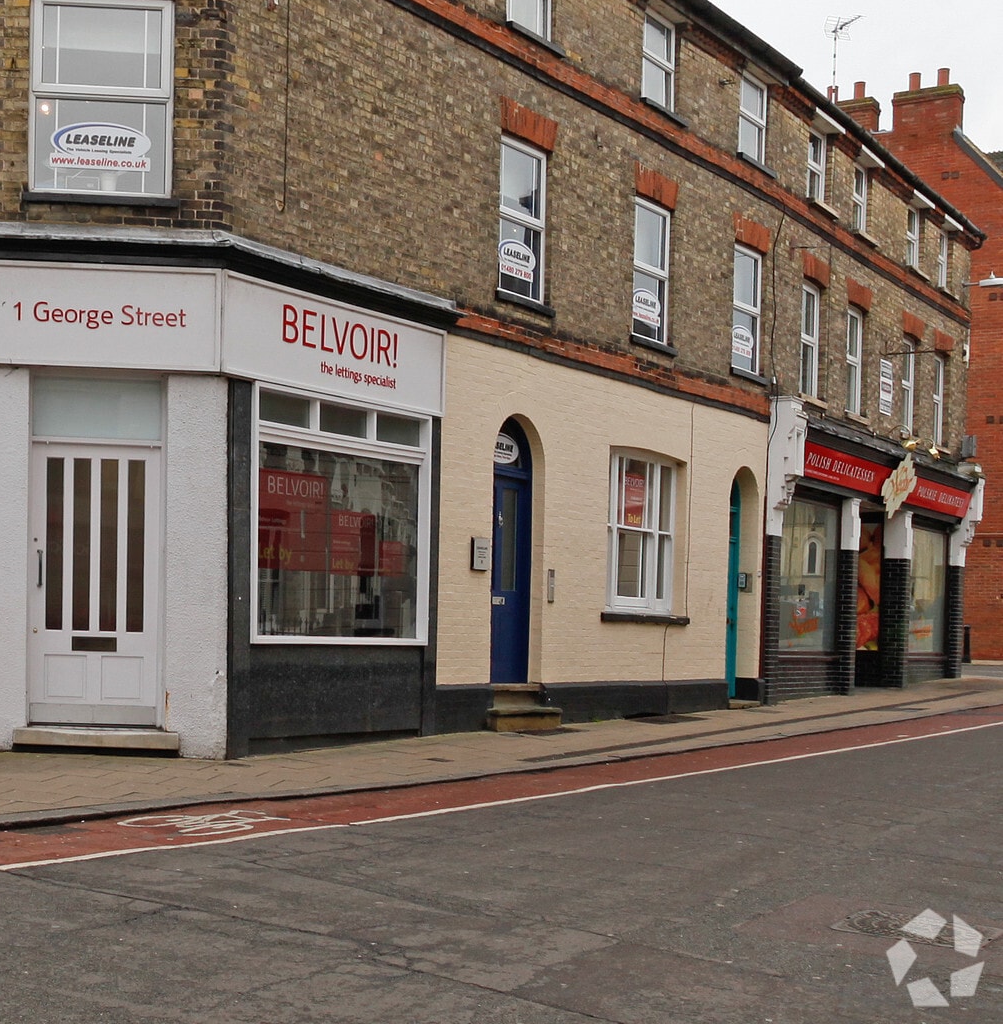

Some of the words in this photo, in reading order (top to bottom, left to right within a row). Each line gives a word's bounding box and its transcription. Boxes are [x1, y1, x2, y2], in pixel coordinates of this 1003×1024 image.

[65, 133, 137, 148] LEASELINE
[51, 156, 147, 169] www.leaseline.co.uk
[503, 246, 531, 263] LEASELINE
[13, 301, 22, 321] 1
[33, 301, 114, 329] George
[121, 305, 187, 327] Street
[282, 304, 398, 368] BELVOIR!
[320, 361, 333, 375] the
[335, 364, 363, 384] lettings
[363, 374, 397, 389] specialist
[495, 441, 514, 453] SELINE
[806, 452, 832, 470] POLISH
[832, 460, 876, 482] DELICATESSEN
[267, 475, 324, 499] BELVOIR!
[627, 513, 634, 523] To
[634, 514, 642, 524] Let
[279, 544, 292, 565] by
